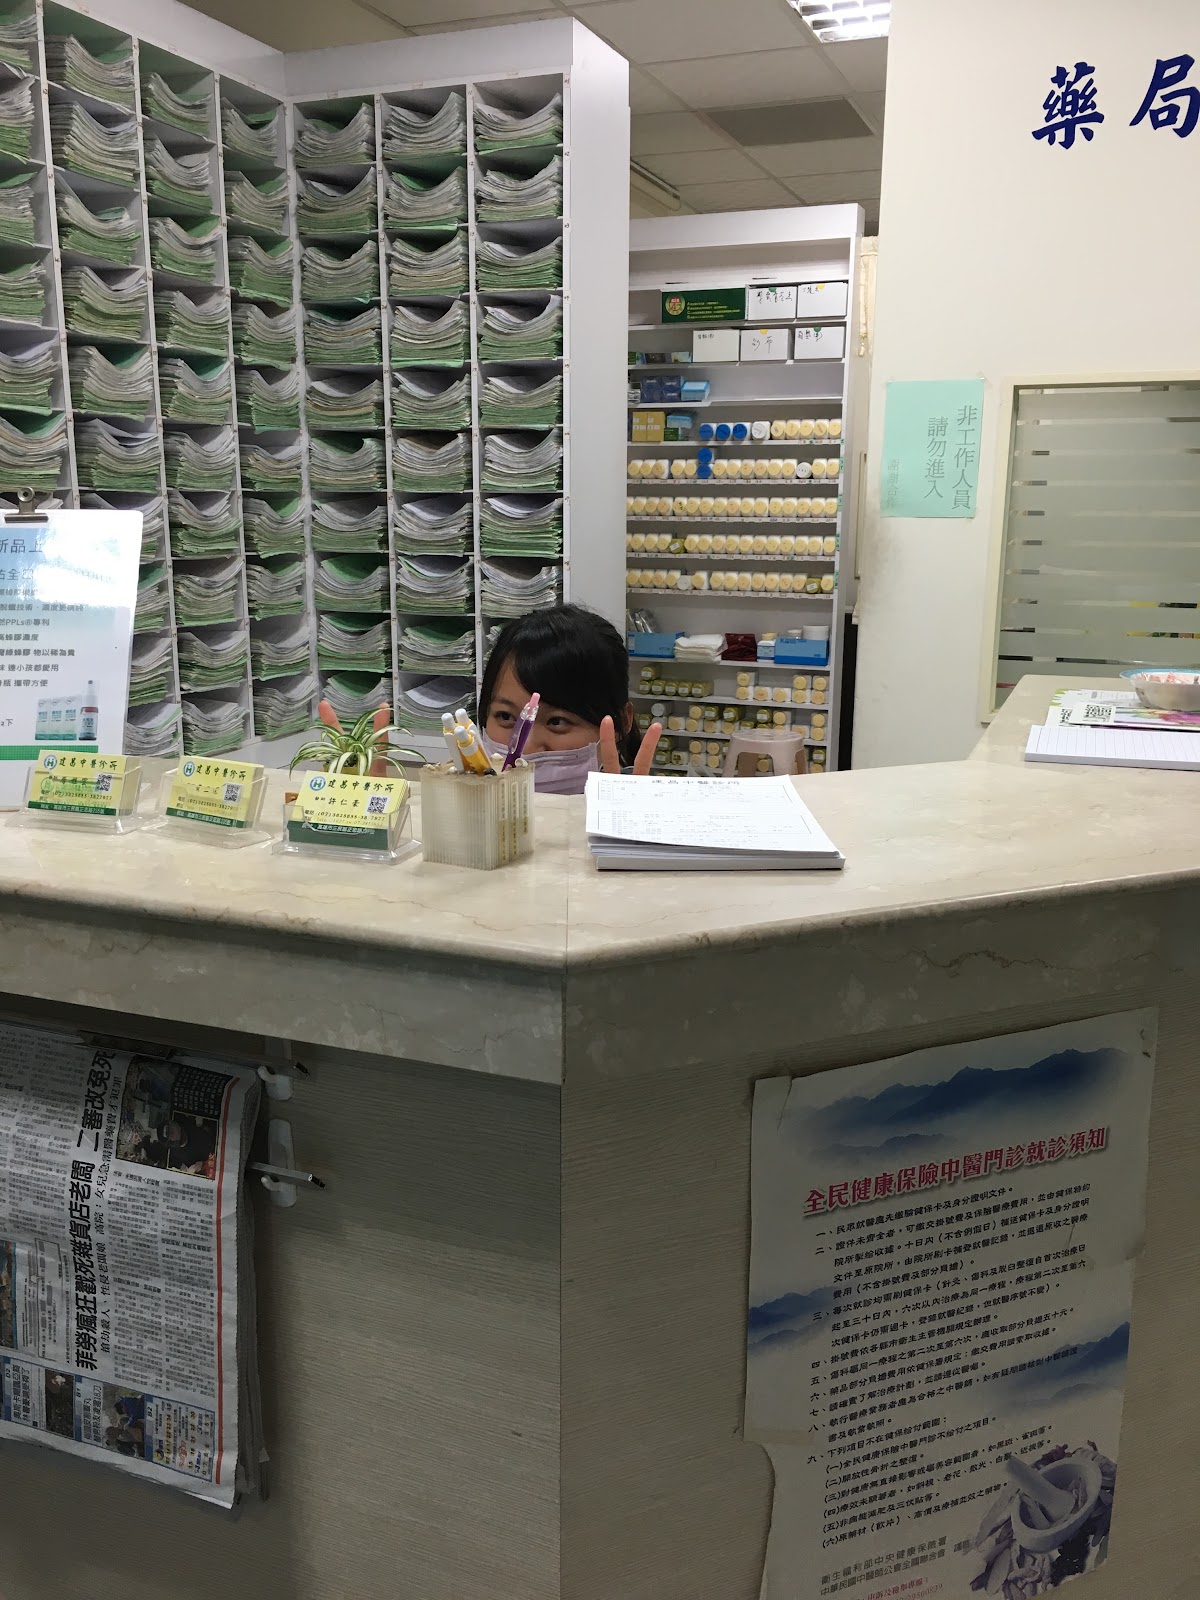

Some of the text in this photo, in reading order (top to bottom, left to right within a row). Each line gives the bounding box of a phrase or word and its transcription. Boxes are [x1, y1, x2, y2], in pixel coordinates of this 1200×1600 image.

[1031, 54, 1200, 150] 藥局
[924, 416, 948, 499] 請勿進入
[951, 405, 977, 510] 非工作人員
[8, 664, 59, 672] 連小孩都愛用
[33, 649, 75, 657] 物以稀為貴
[328, 778, 394, 793] 建昌中醫診所
[67, 1050, 116, 1371] 菲勞瘋狂戳死雜貨店老闆 二審改免死
[803, 1126, 1105, 1214] 全民健康保險中醫門診就診須知
